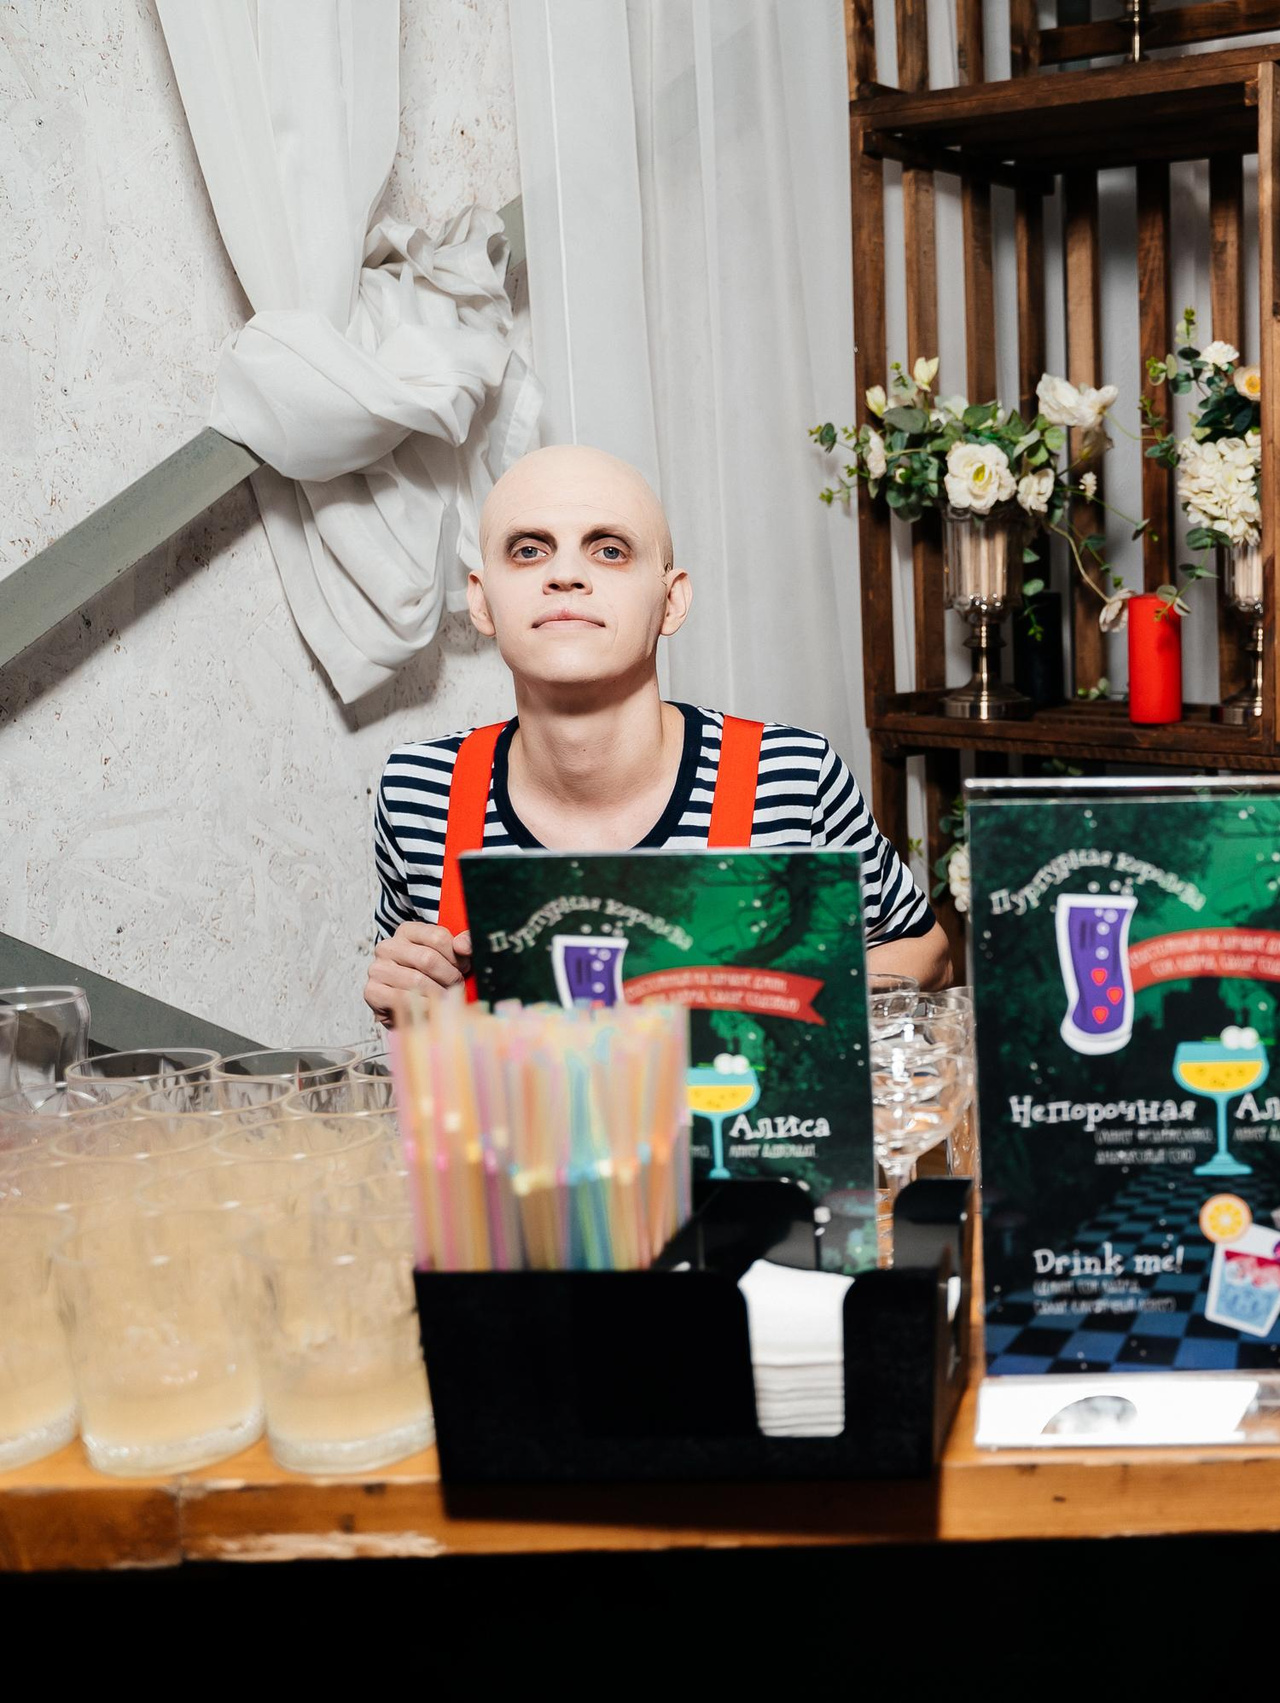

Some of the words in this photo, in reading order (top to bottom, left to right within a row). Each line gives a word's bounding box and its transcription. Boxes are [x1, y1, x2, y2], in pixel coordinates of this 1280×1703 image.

[988, 847, 1113, 916] Пурпурная
[730, 1113, 832, 1140] Алиса
[1009, 1093, 1196, 1131] Непорочная
[1032, 1241, 1125, 1276] Drink
[1133, 1244, 1185, 1275] me!
